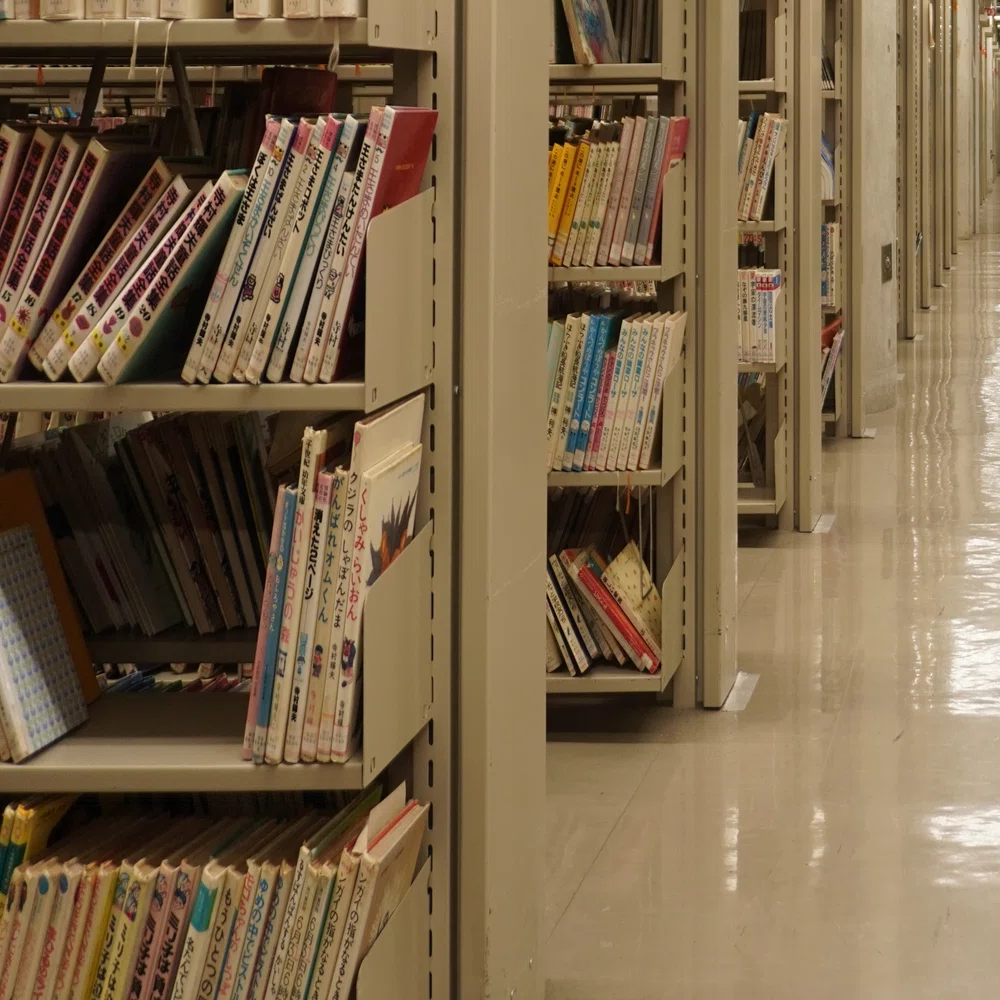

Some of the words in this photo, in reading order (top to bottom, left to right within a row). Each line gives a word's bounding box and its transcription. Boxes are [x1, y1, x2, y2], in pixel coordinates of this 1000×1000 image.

[6, 145, 69, 291] 寺村輝夫童話全集
[29, 151, 99, 297] 寺村輝夫童話全集
[78, 167, 165, 297] 寺村輝夫童話全集
[293, 149, 325, 234] 王さまロボット
[93, 184, 182, 308] 寺村輝夫童話全集
[121, 190, 208, 313] 寺村輝夫童話全集
[146, 185, 226, 312] 寺村輝夫童話全集
[1, 290, 11, 303] 15
[24, 294, 36, 308] 16
[71, 290, 82, 303] 17
[85, 303, 97, 317] 18
[114, 306, 126, 321] 19
[139, 304, 152, 322] 20
[343, 471, 358, 532] クジラの
[353, 488, 369, 551] くしゃみ
[304, 508, 324, 600] 消えた2ページ
[318, 474, 345, 625] がんばれオムくん
[333, 538, 351, 628] しゃぼんだま
[346, 555, 362, 622] らいおん
[196, 889, 232, 1000] もうひとつの
